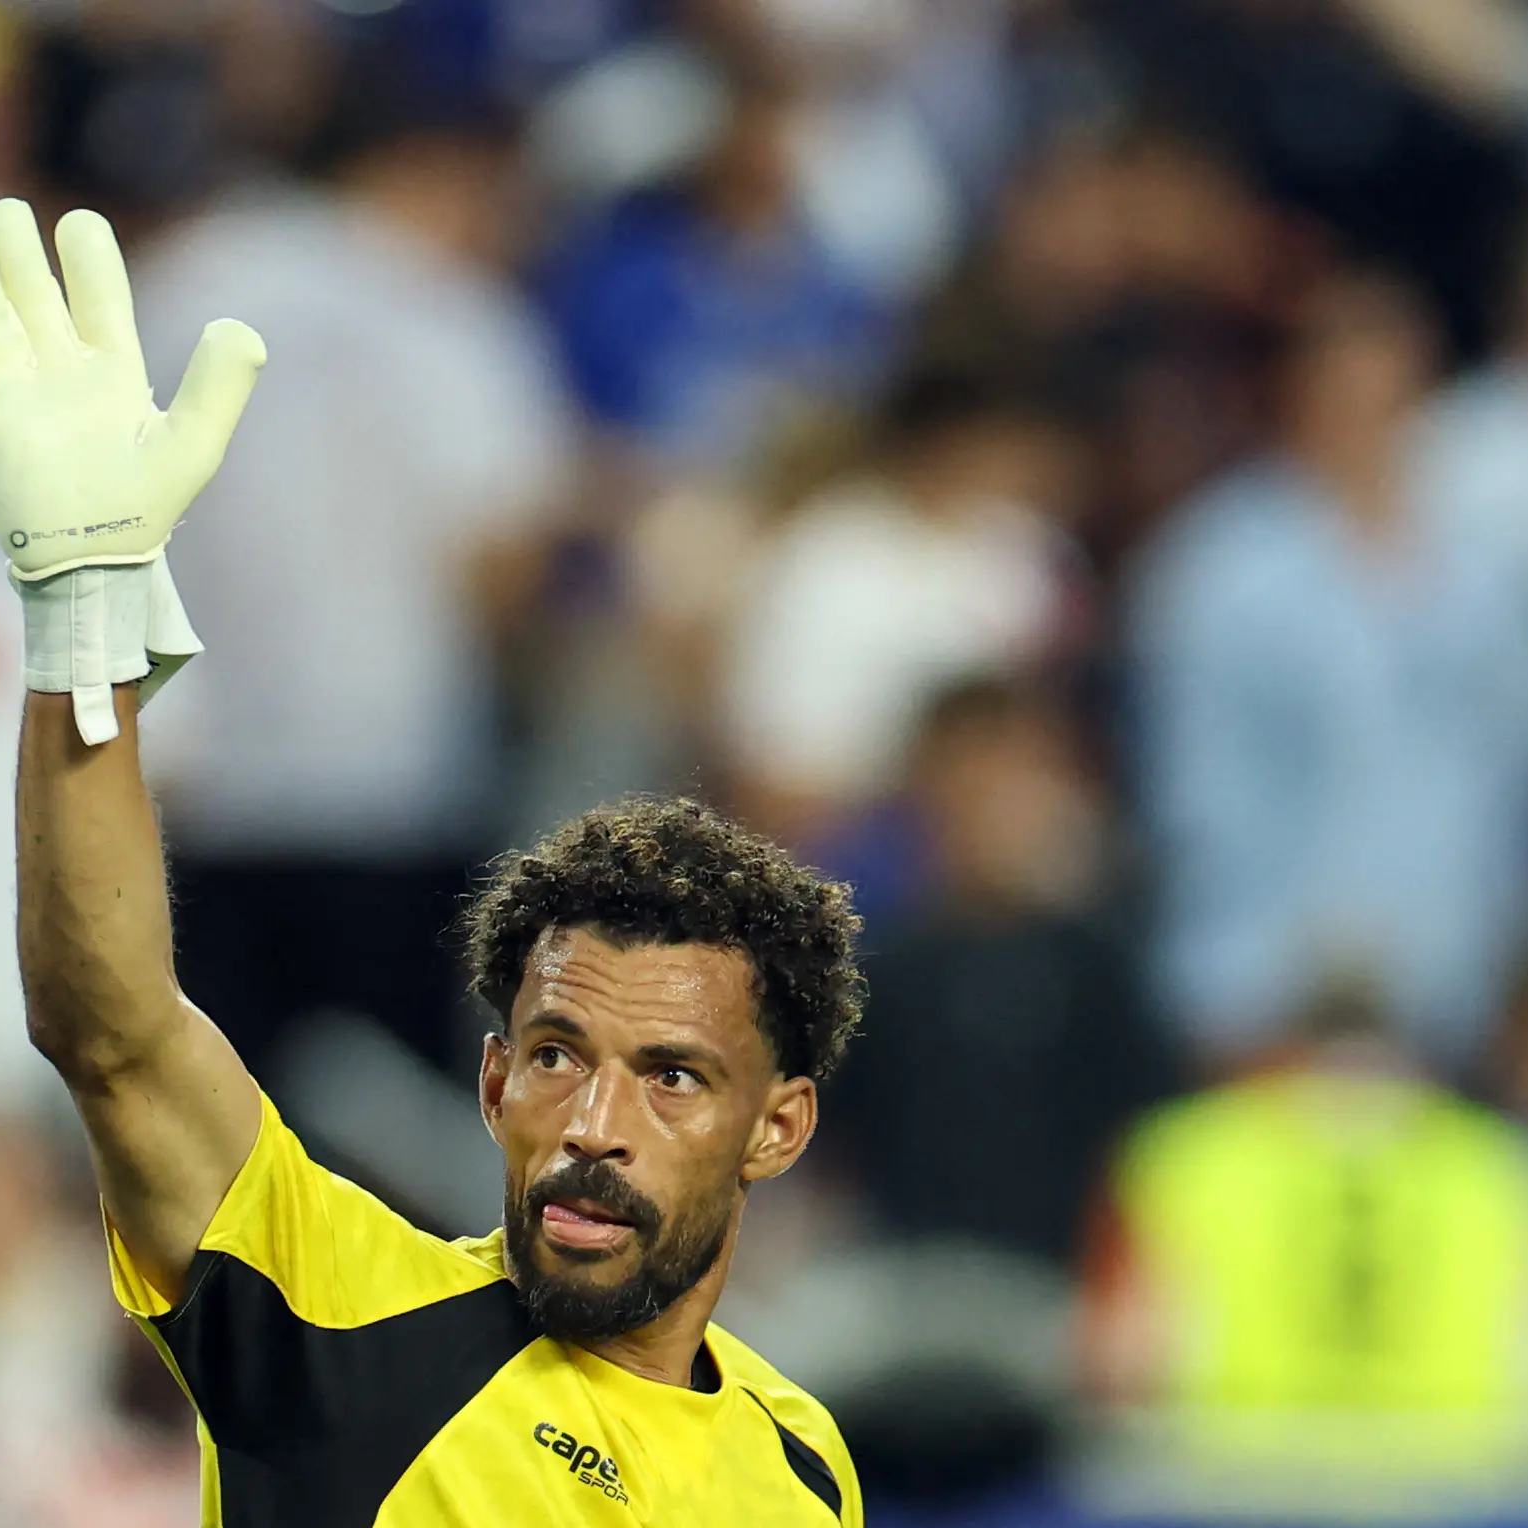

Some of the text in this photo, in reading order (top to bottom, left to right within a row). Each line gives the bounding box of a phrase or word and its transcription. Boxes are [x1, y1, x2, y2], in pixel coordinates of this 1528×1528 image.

[83, 516, 143, 533] SPORT
[533, 1421, 621, 1485] cape
[578, 1470, 630, 1507] SPOR
